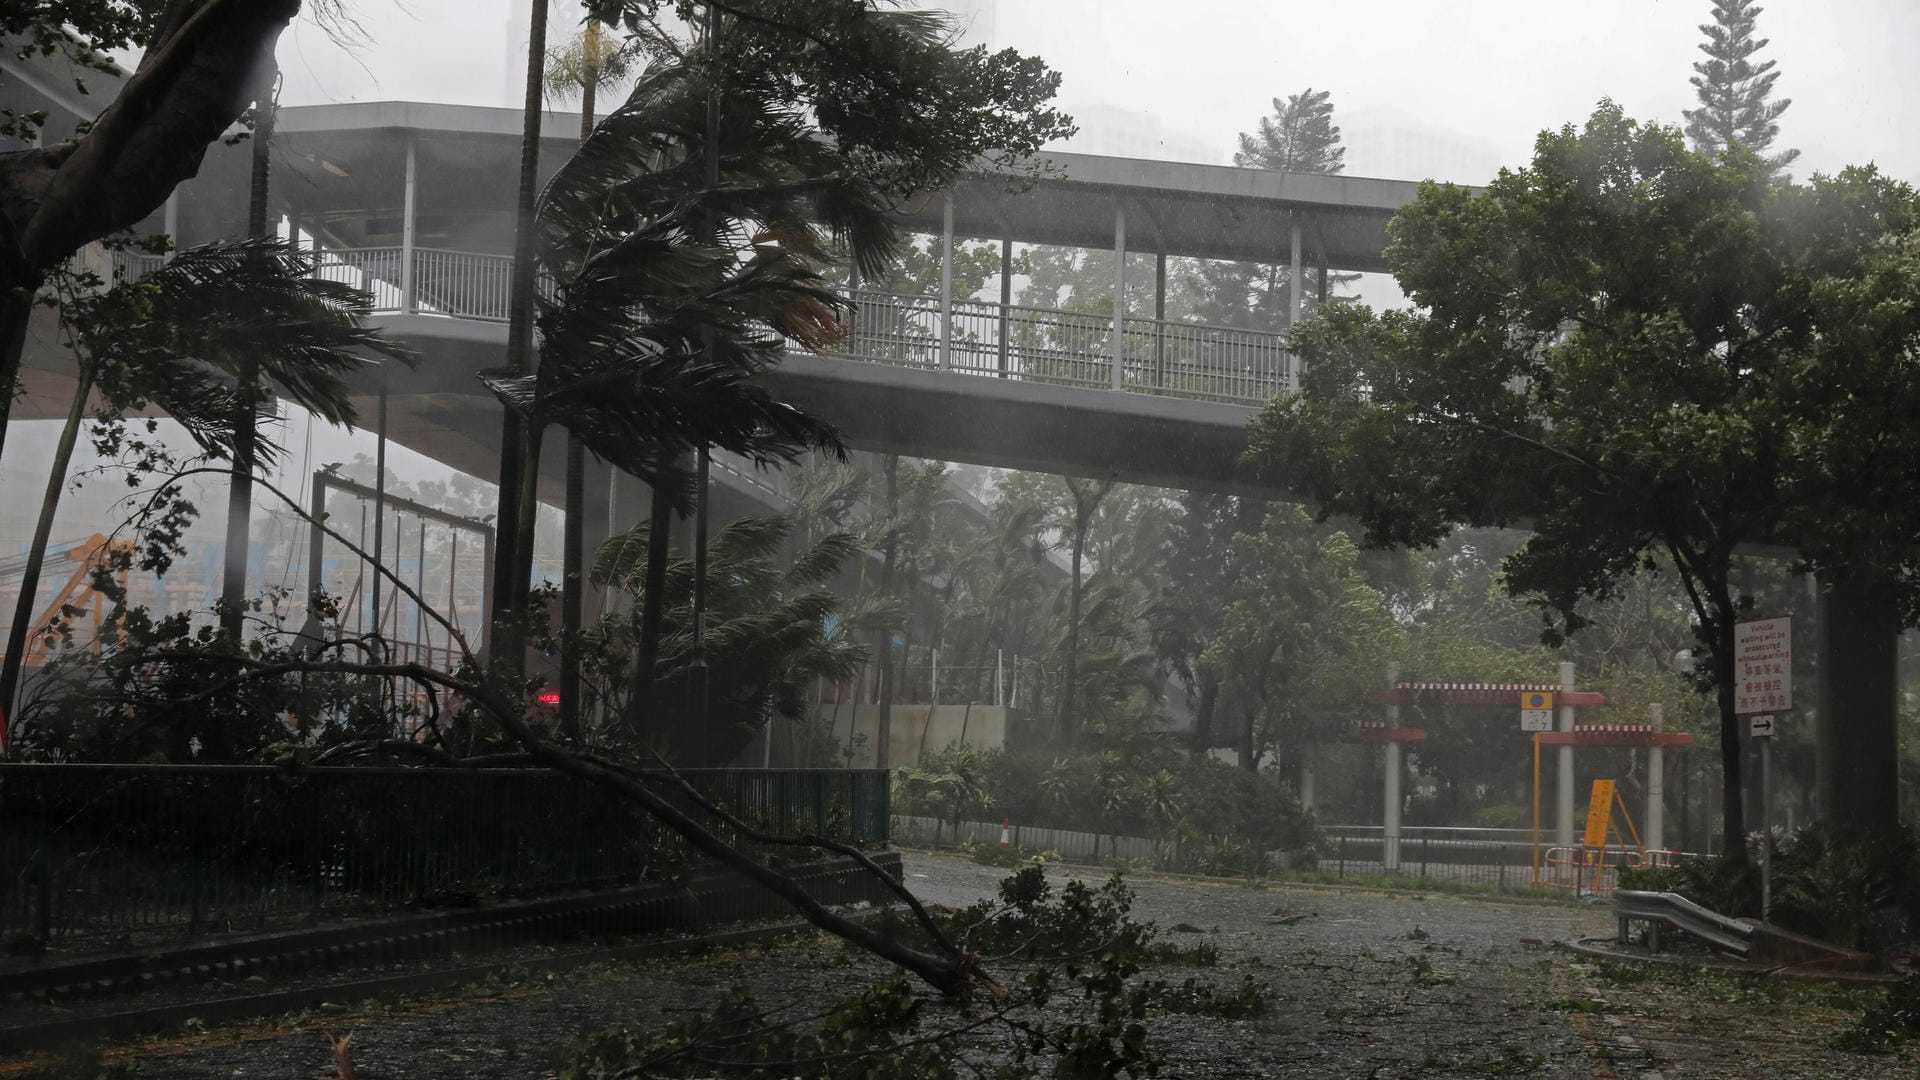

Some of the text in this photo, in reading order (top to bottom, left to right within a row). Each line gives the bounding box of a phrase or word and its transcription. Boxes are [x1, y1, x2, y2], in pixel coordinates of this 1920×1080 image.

[1751, 623, 1774, 632] Vehicle
[1741, 635, 1763, 643] waiting
[1744, 642, 1780, 653] prosecuted
